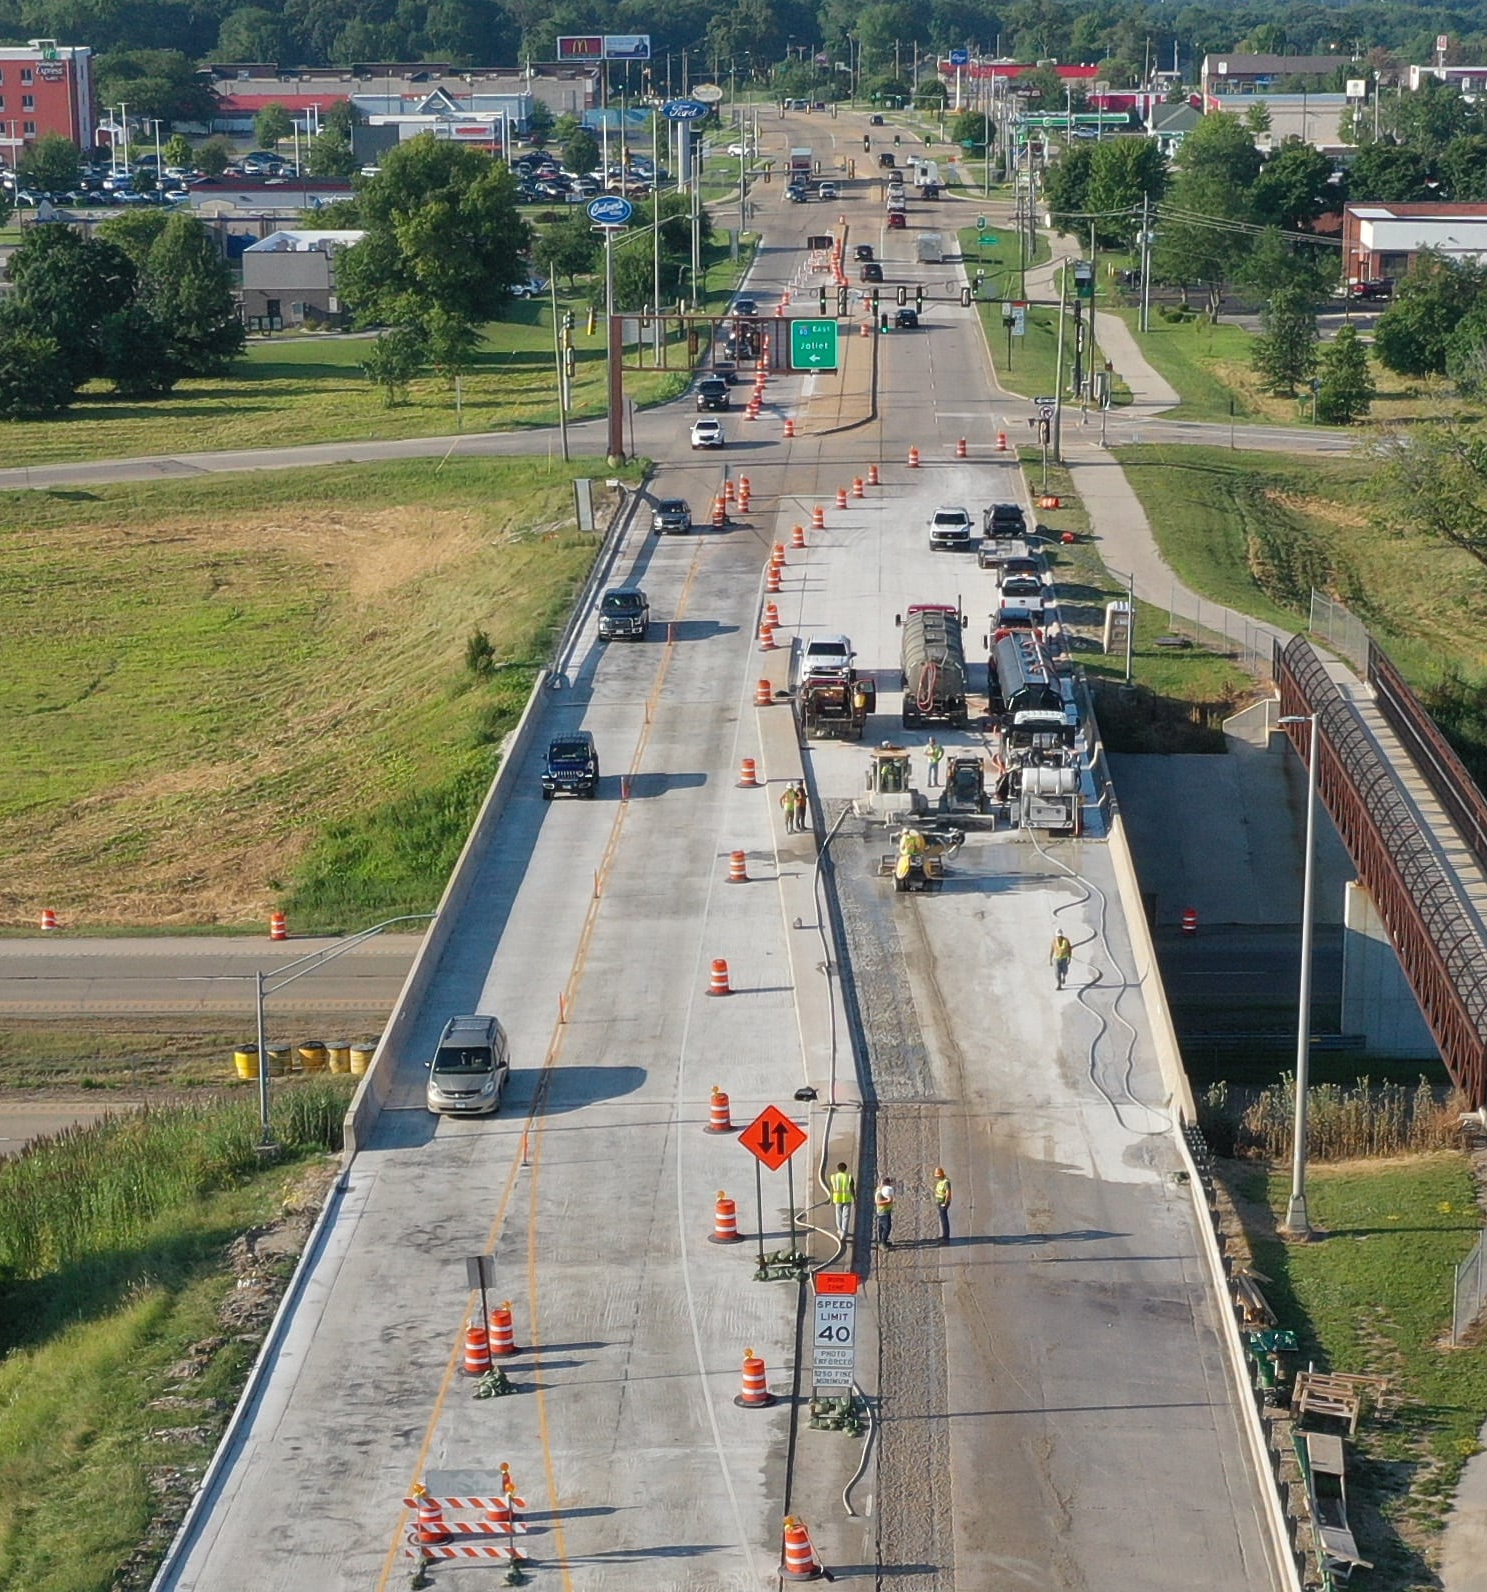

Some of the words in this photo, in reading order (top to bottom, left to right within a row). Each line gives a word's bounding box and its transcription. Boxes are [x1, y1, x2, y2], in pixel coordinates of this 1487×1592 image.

[669, 105, 698, 117] Ford
[800, 342, 829, 350] Joliet
[817, 1300, 853, 1309] SPEED
[820, 1313, 849, 1321] LIMIT
[818, 1325, 850, 1342] 40
[820, 1350, 847, 1358] PHOTO
